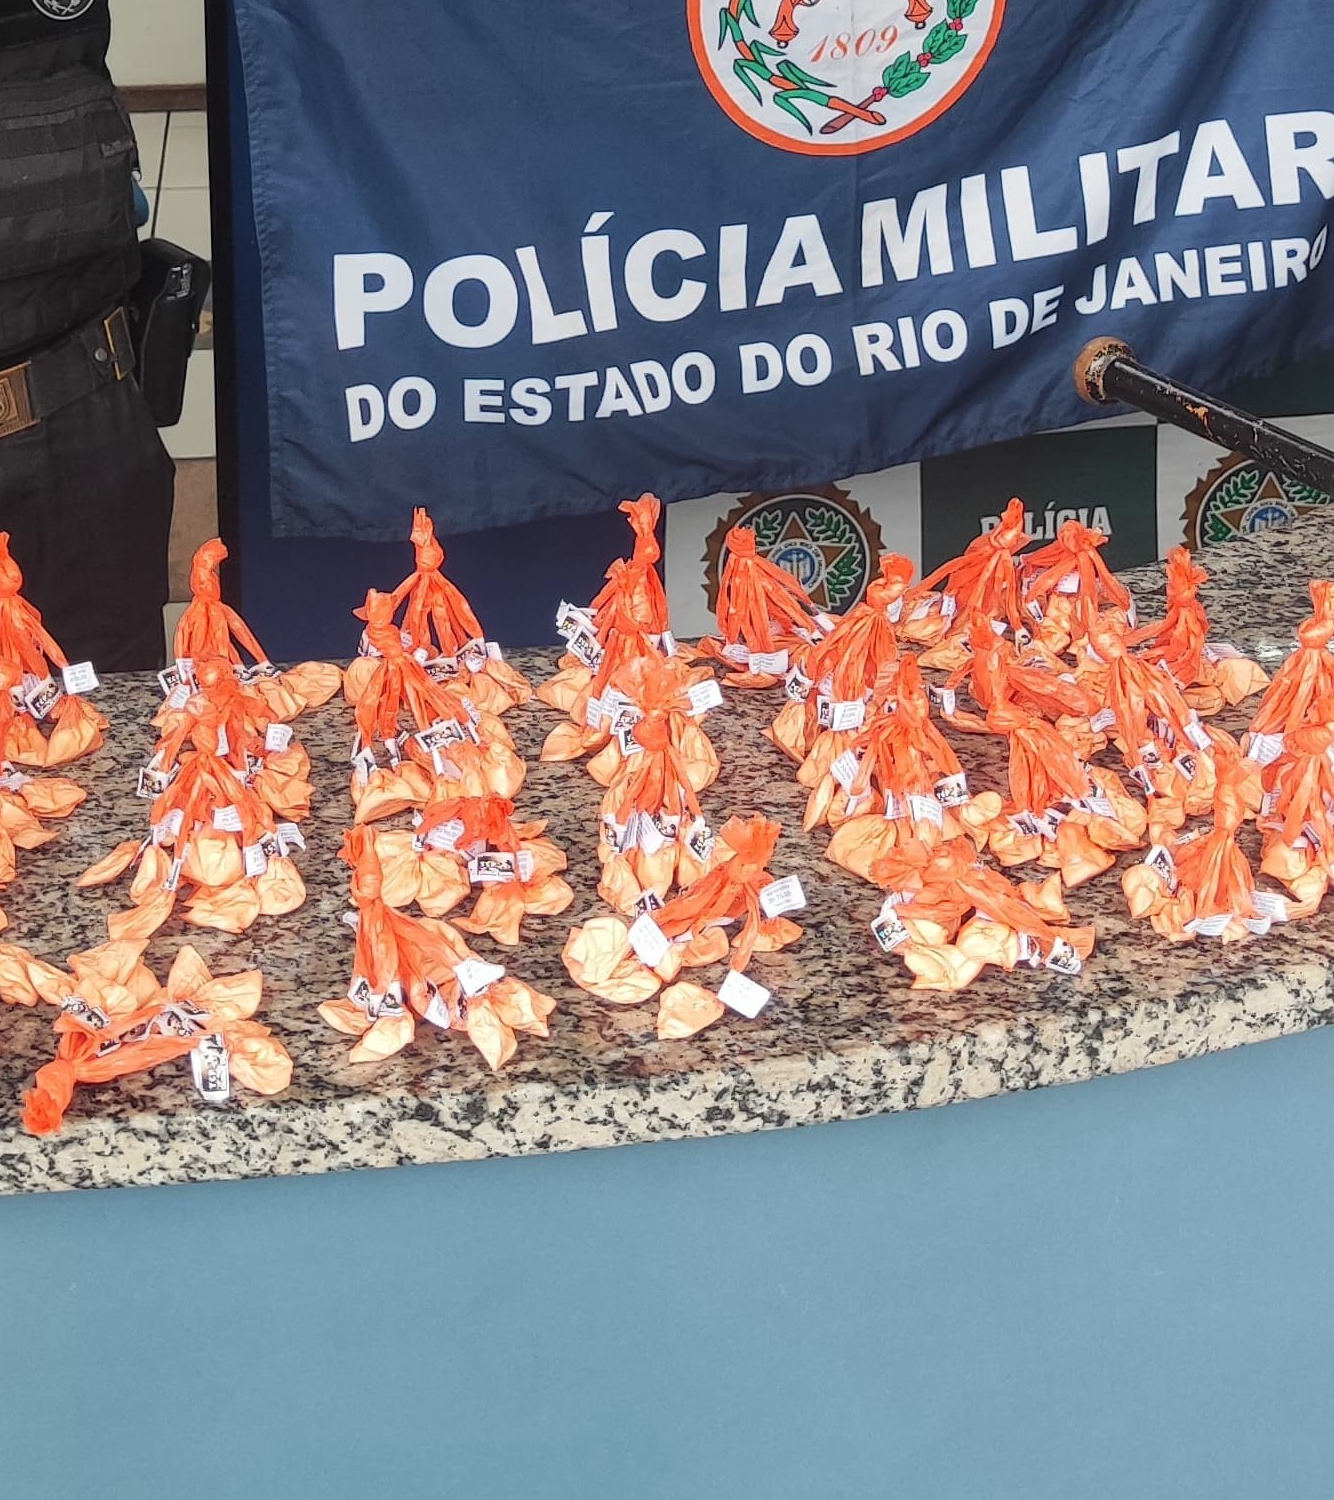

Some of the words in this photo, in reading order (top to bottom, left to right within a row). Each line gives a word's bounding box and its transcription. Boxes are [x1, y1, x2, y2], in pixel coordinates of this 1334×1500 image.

[806, 23, 900, 64] 1809
[331, 209, 845, 352] POLÍCIA
[342, 373, 438, 443] DO
[460, 349, 717, 429] ESTADO
[738, 332, 835, 395] DO
[854, 306, 971, 377] RIO
[988, 283, 1066, 352] DE
[1072, 222, 1329, 318] JANEIRO
